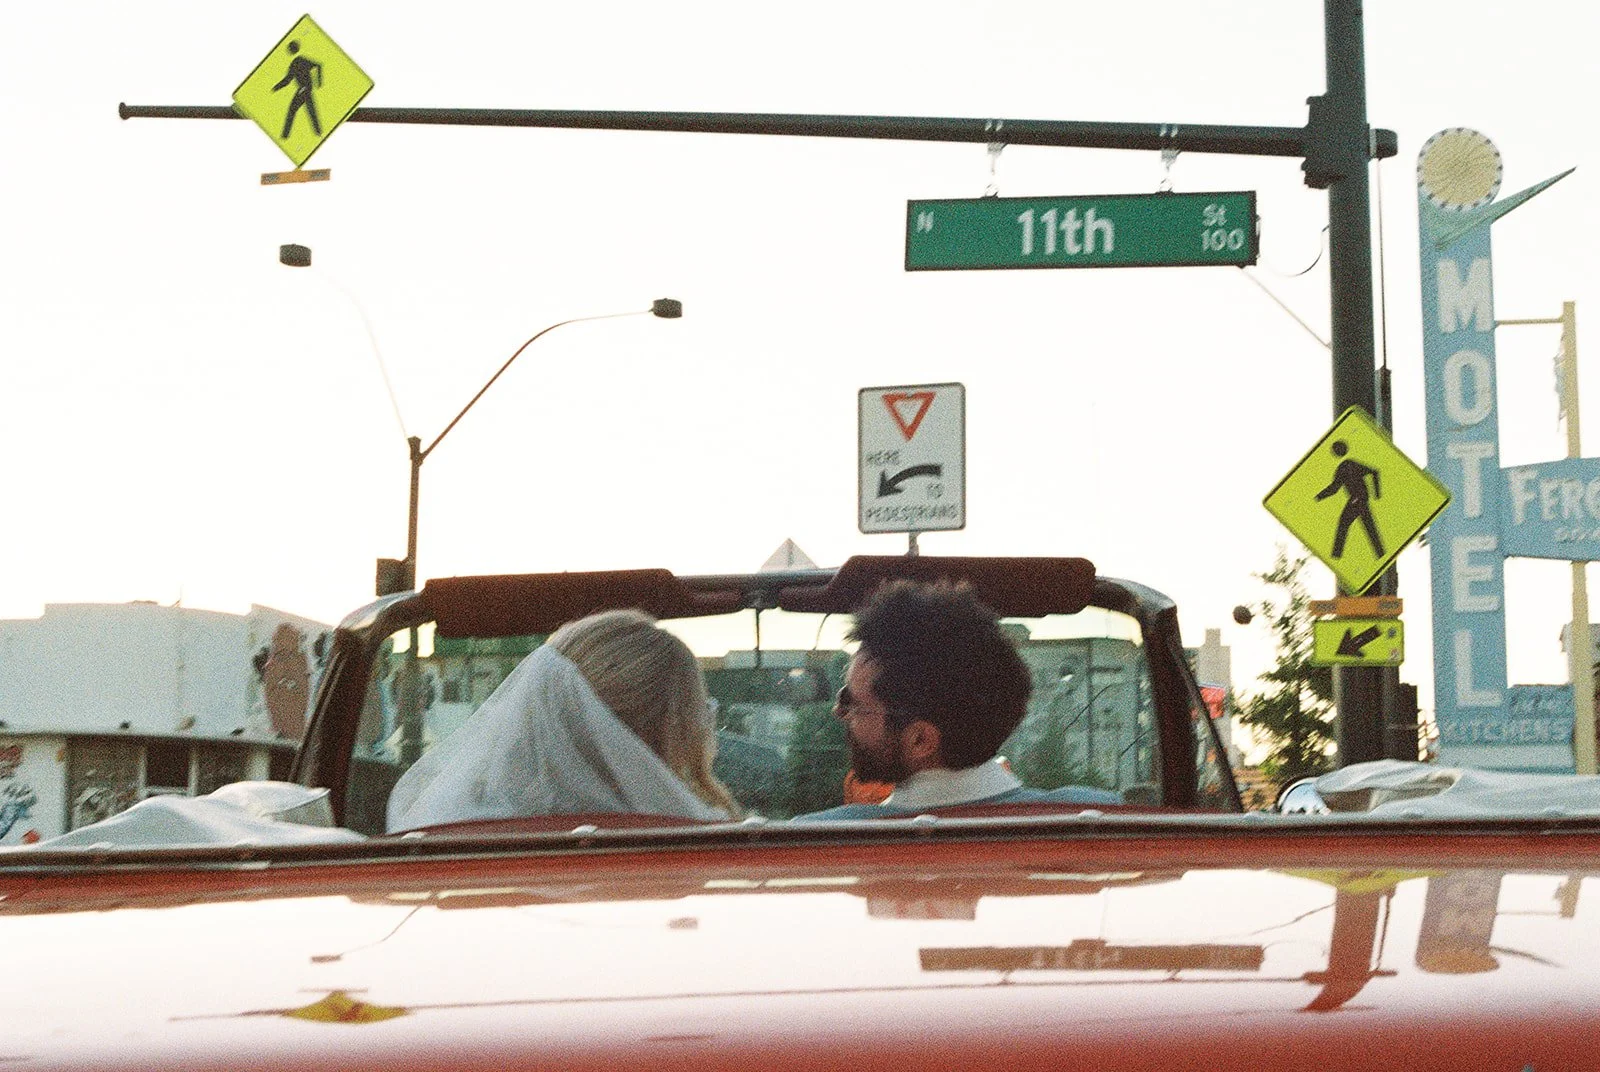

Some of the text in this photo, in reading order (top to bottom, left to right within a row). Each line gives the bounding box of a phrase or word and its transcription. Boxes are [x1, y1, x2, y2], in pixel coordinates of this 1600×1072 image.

[915, 203, 1228, 256] N 11th St
[1201, 227, 1245, 252] 100
[1436, 257, 1502, 708] MOTEL
[1442, 718, 1570, 742] KITCHENS
